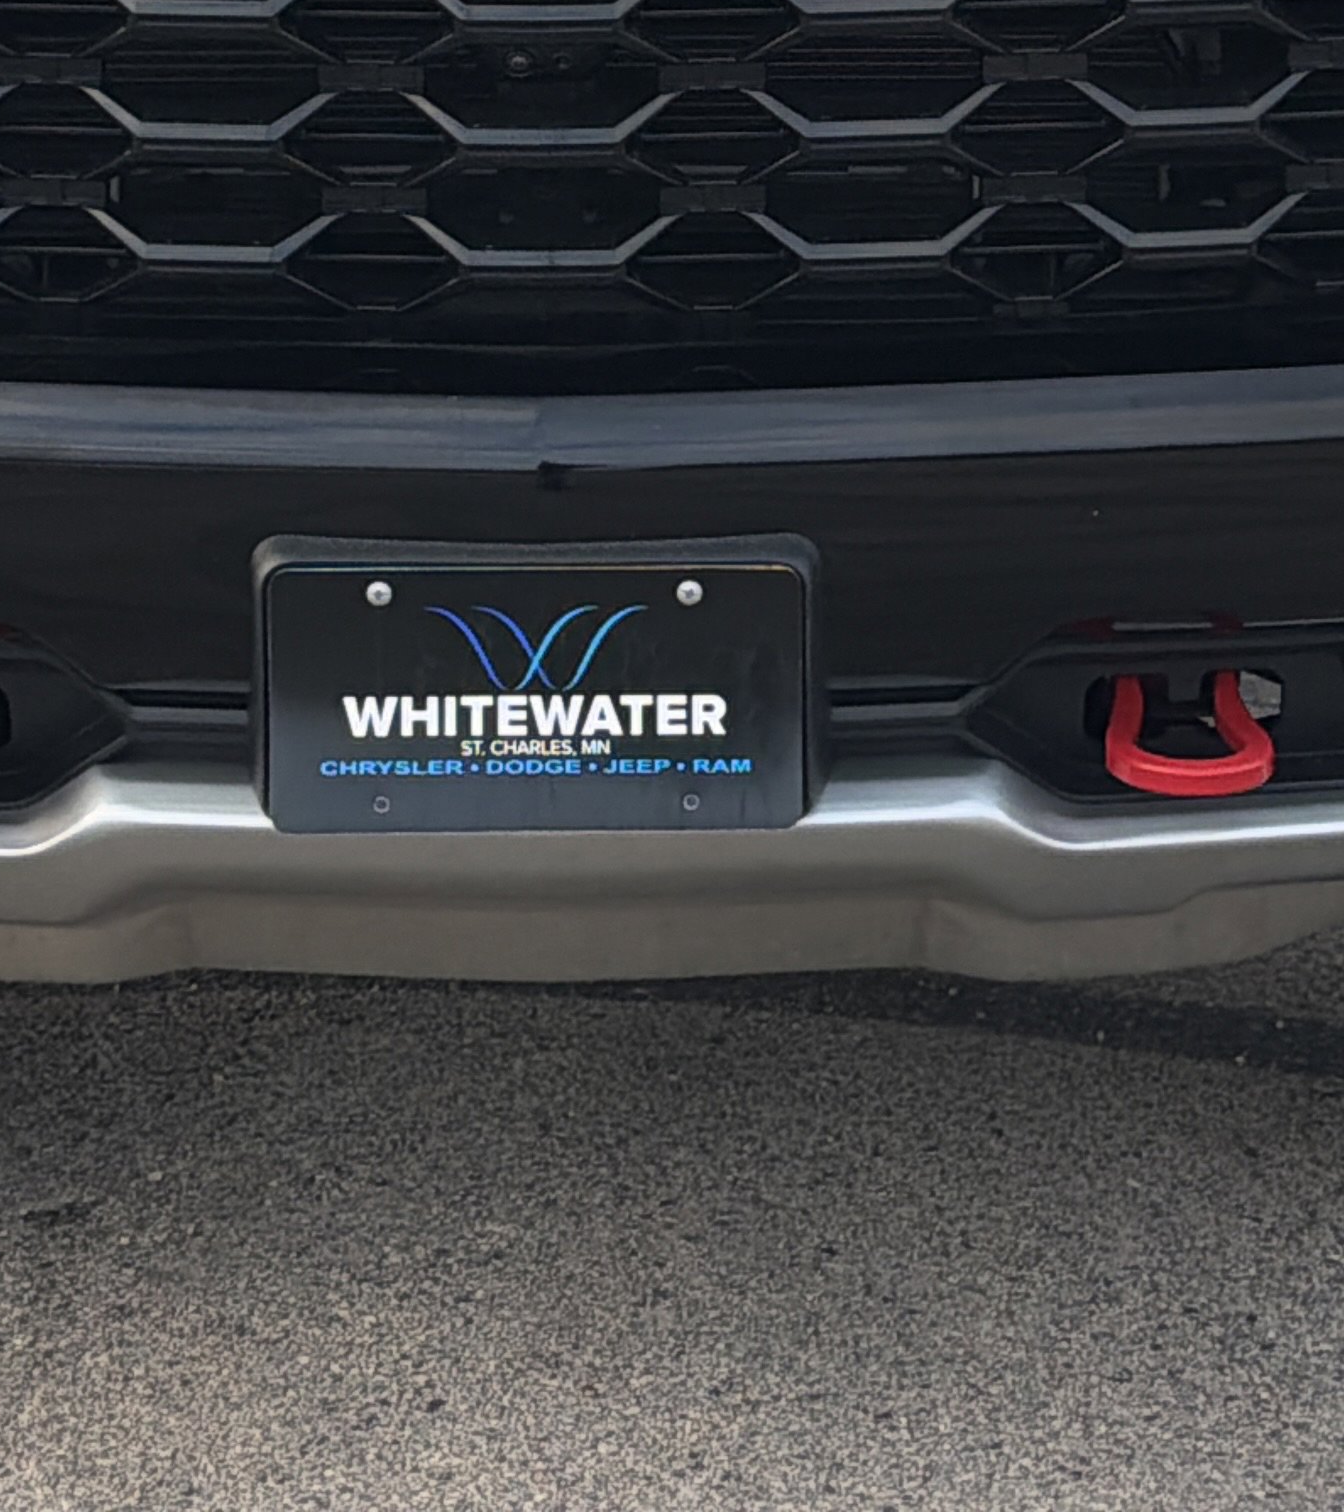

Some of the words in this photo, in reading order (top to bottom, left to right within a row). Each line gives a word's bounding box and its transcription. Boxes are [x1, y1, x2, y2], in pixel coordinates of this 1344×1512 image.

[342, 695, 727, 737] WHITEWATER
[460, 740, 487, 756] ST.
[490, 740, 577, 758] CHARLES,
[580, 739, 611, 755] MN
[320, 760, 464, 776] CHRYSLER
[485, 759, 581, 775] DODGE
[603, 758, 671, 774] JEEP
[692, 758, 752, 773] RAM
